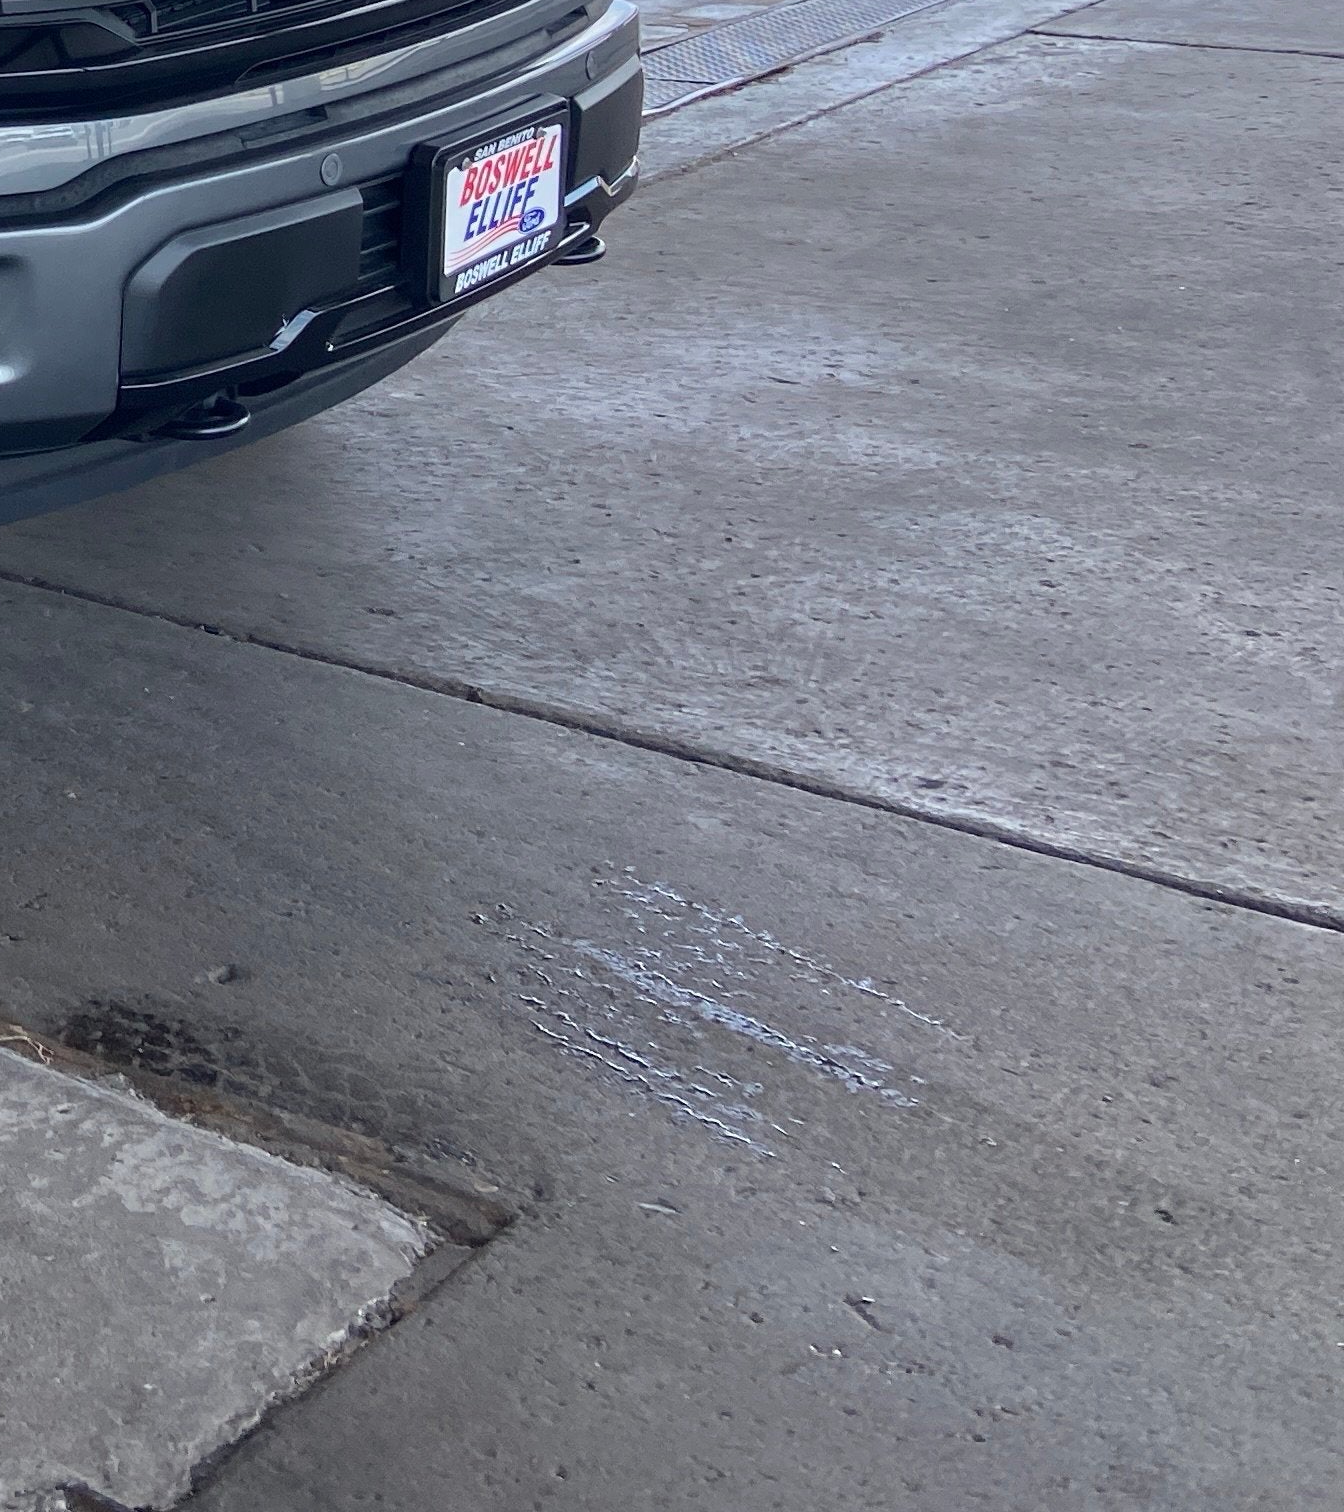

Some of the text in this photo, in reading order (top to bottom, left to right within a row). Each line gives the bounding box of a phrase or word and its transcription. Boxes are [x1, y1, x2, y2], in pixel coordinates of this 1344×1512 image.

[460, 134, 558, 207] BOSWELL
[474, 127, 535, 161] SAN BENITO
[464, 175, 540, 242] ELLIFF
[454, 230, 552, 294] BOSWELL ELLIFF
